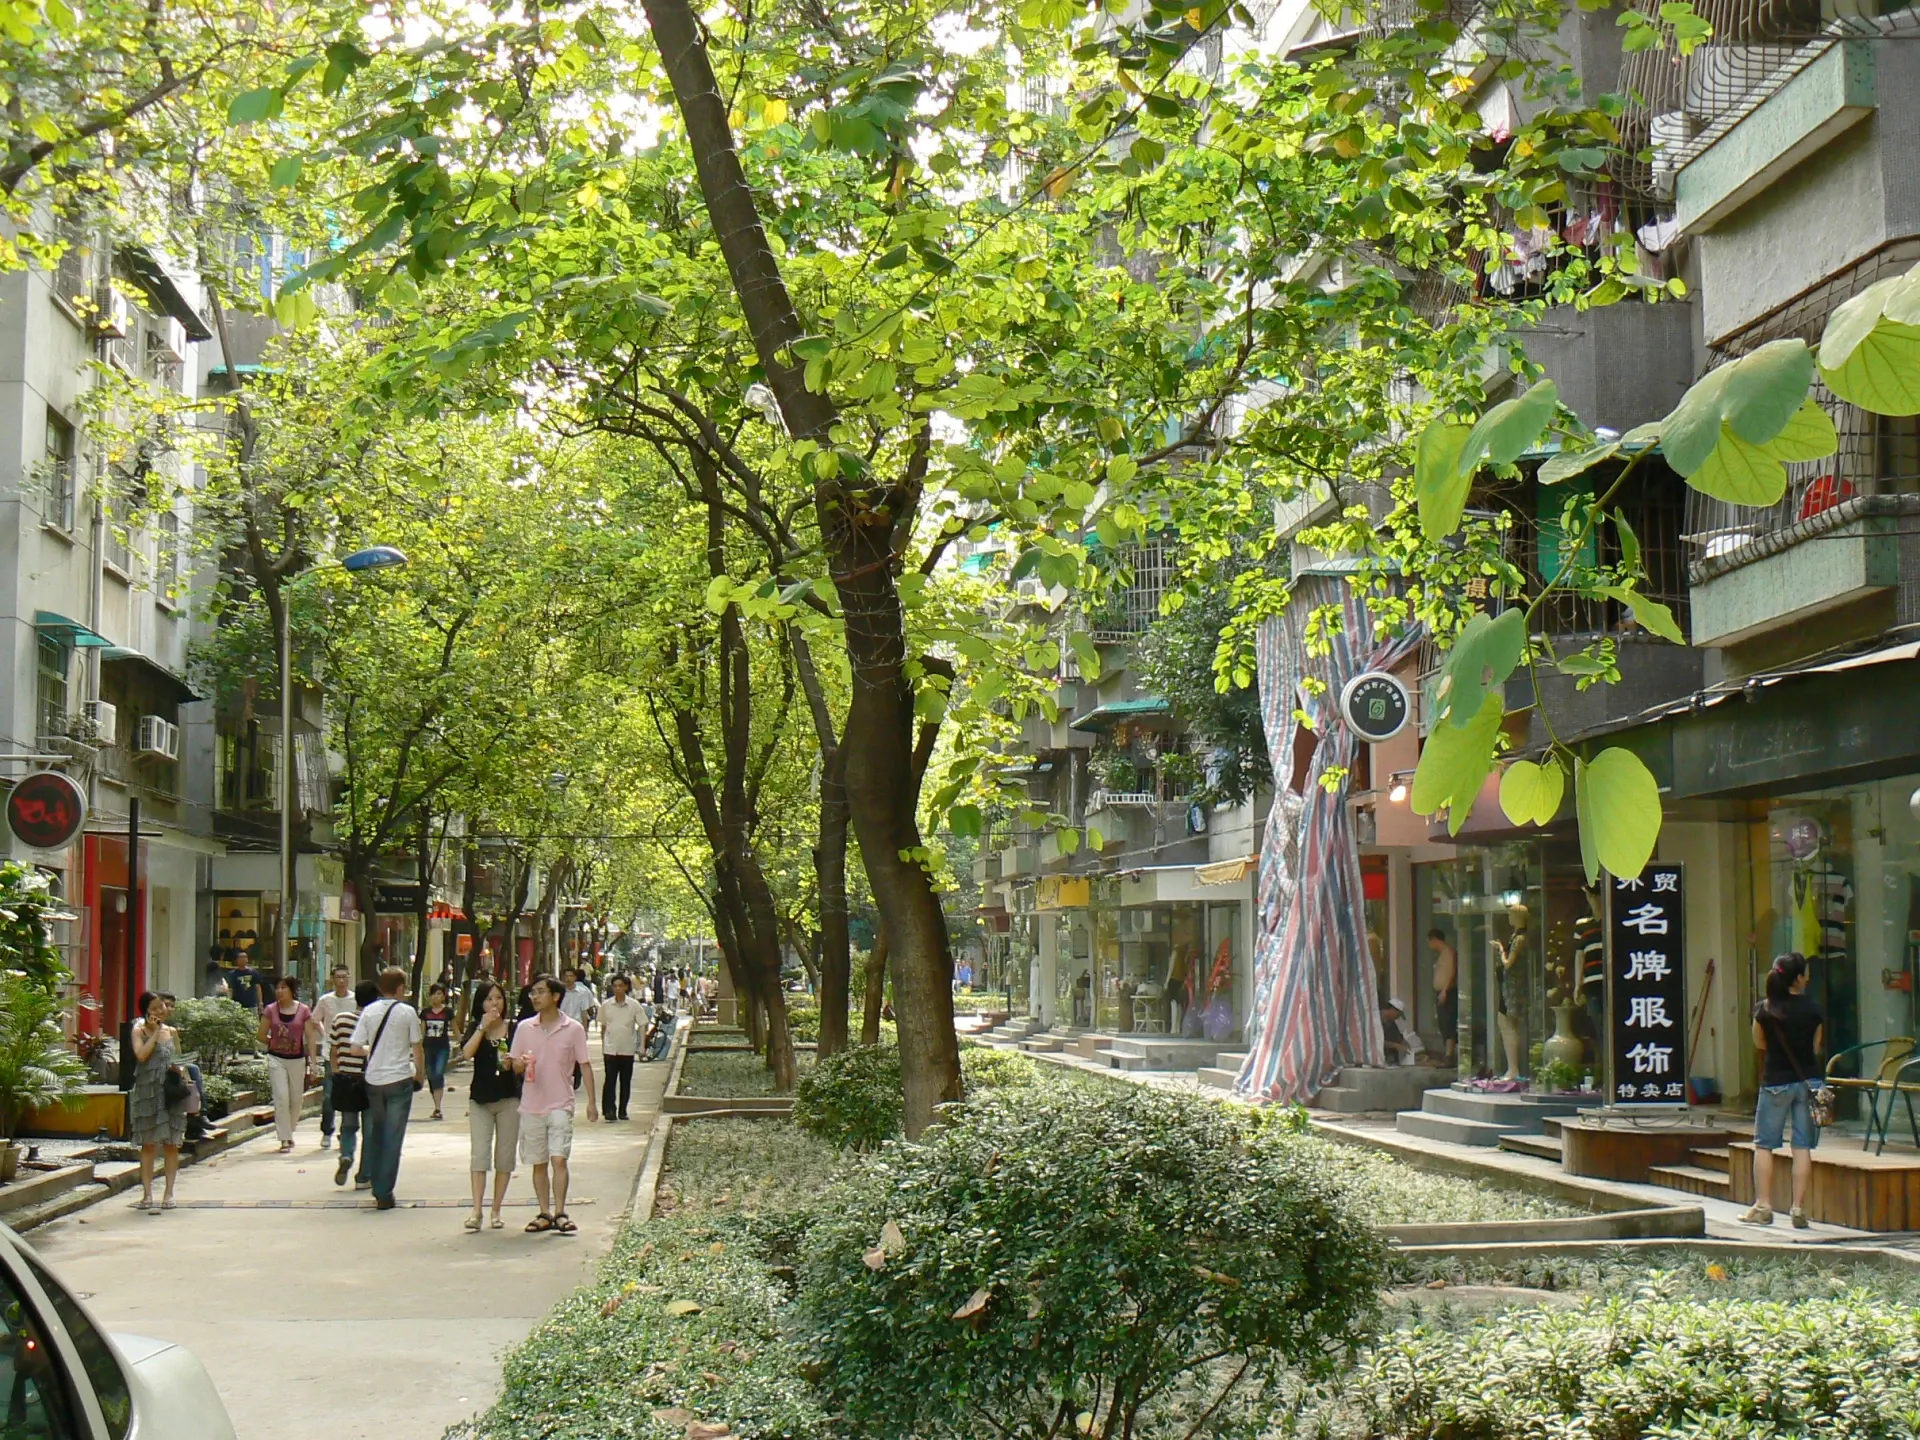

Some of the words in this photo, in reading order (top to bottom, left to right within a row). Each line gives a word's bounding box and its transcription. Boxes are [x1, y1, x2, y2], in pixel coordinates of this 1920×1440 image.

[1622, 903, 1673, 1074] 名牌服饰
[1617, 1083, 1683, 1098] 特卖店
